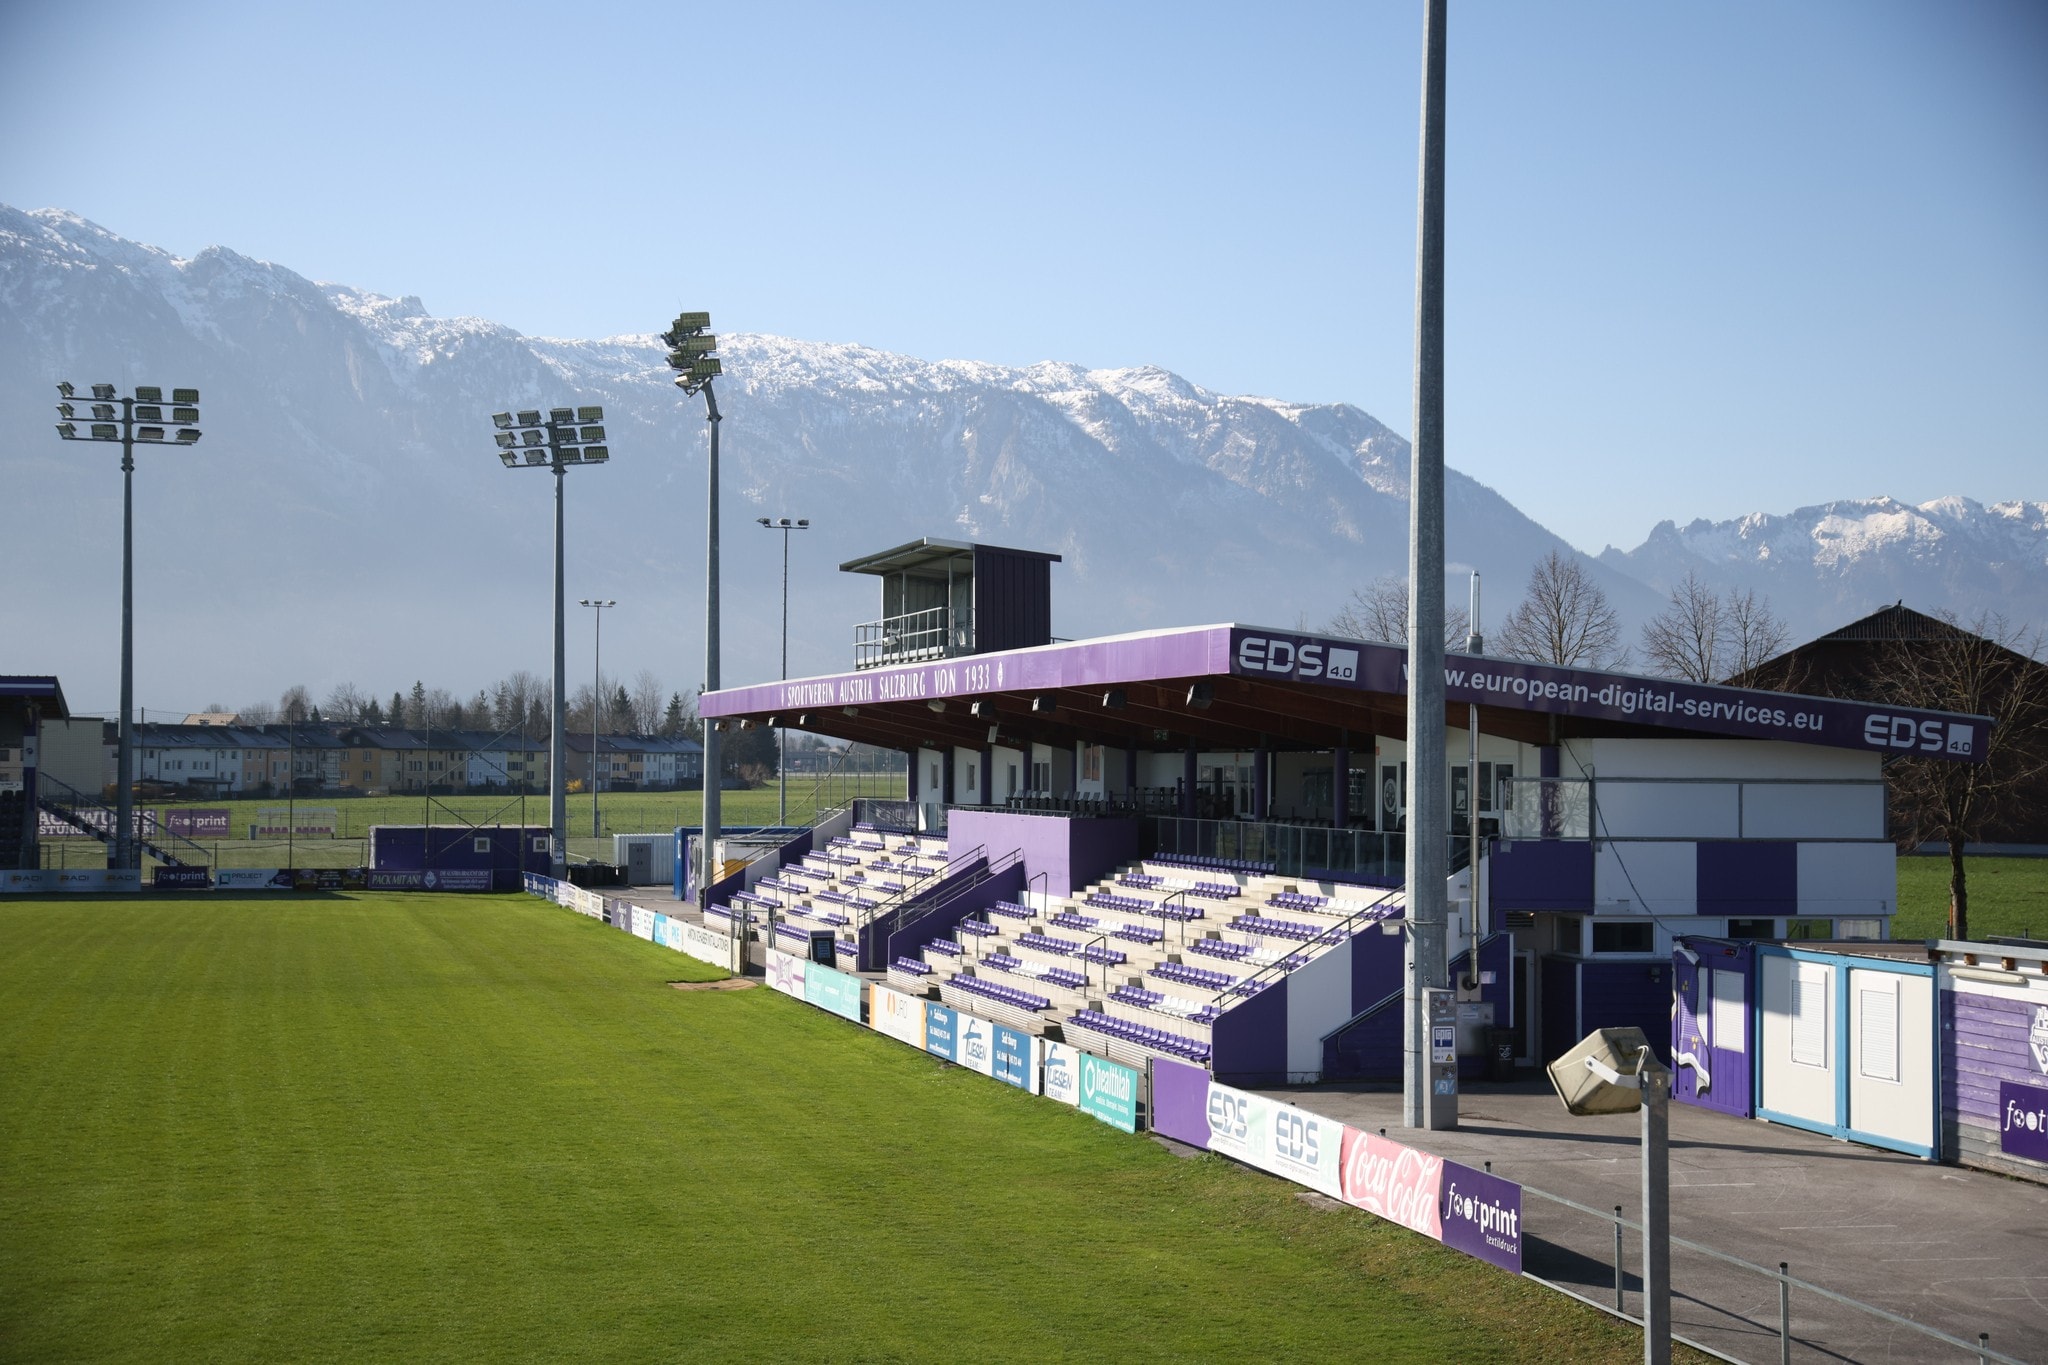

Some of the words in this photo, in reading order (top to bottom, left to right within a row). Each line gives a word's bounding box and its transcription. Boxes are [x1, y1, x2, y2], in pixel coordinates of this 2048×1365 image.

[1239, 637, 1324, 677] EDS
[1330, 666, 1353, 679] 4.0
[787, 681, 834, 707] SPORTVEREIN
[839, 678, 873, 703] AUSTRIA
[879, 671, 926, 699] SALZBURG
[934, 668, 957, 695] VON
[965, 664, 990, 692] 1933
[1403, 662, 1824, 731] w.european-digital-services.eu
[1864, 713, 1944, 752] EDS
[1949, 740, 1972, 754] 4.0
[157, 871, 206, 882] footprint
[371, 874, 391, 885] PACK
[391, 874, 406, 885] MIT
[1095, 1061, 1130, 1102] healthlab
[1208, 1090, 1248, 1139] EDS
[2004, 1100, 2048, 1133] foot
[1275, 1110, 1319, 1166] EDS
[1445, 1182, 1519, 1238] footprint
[1486, 1233, 1518, 1255] textildruck
